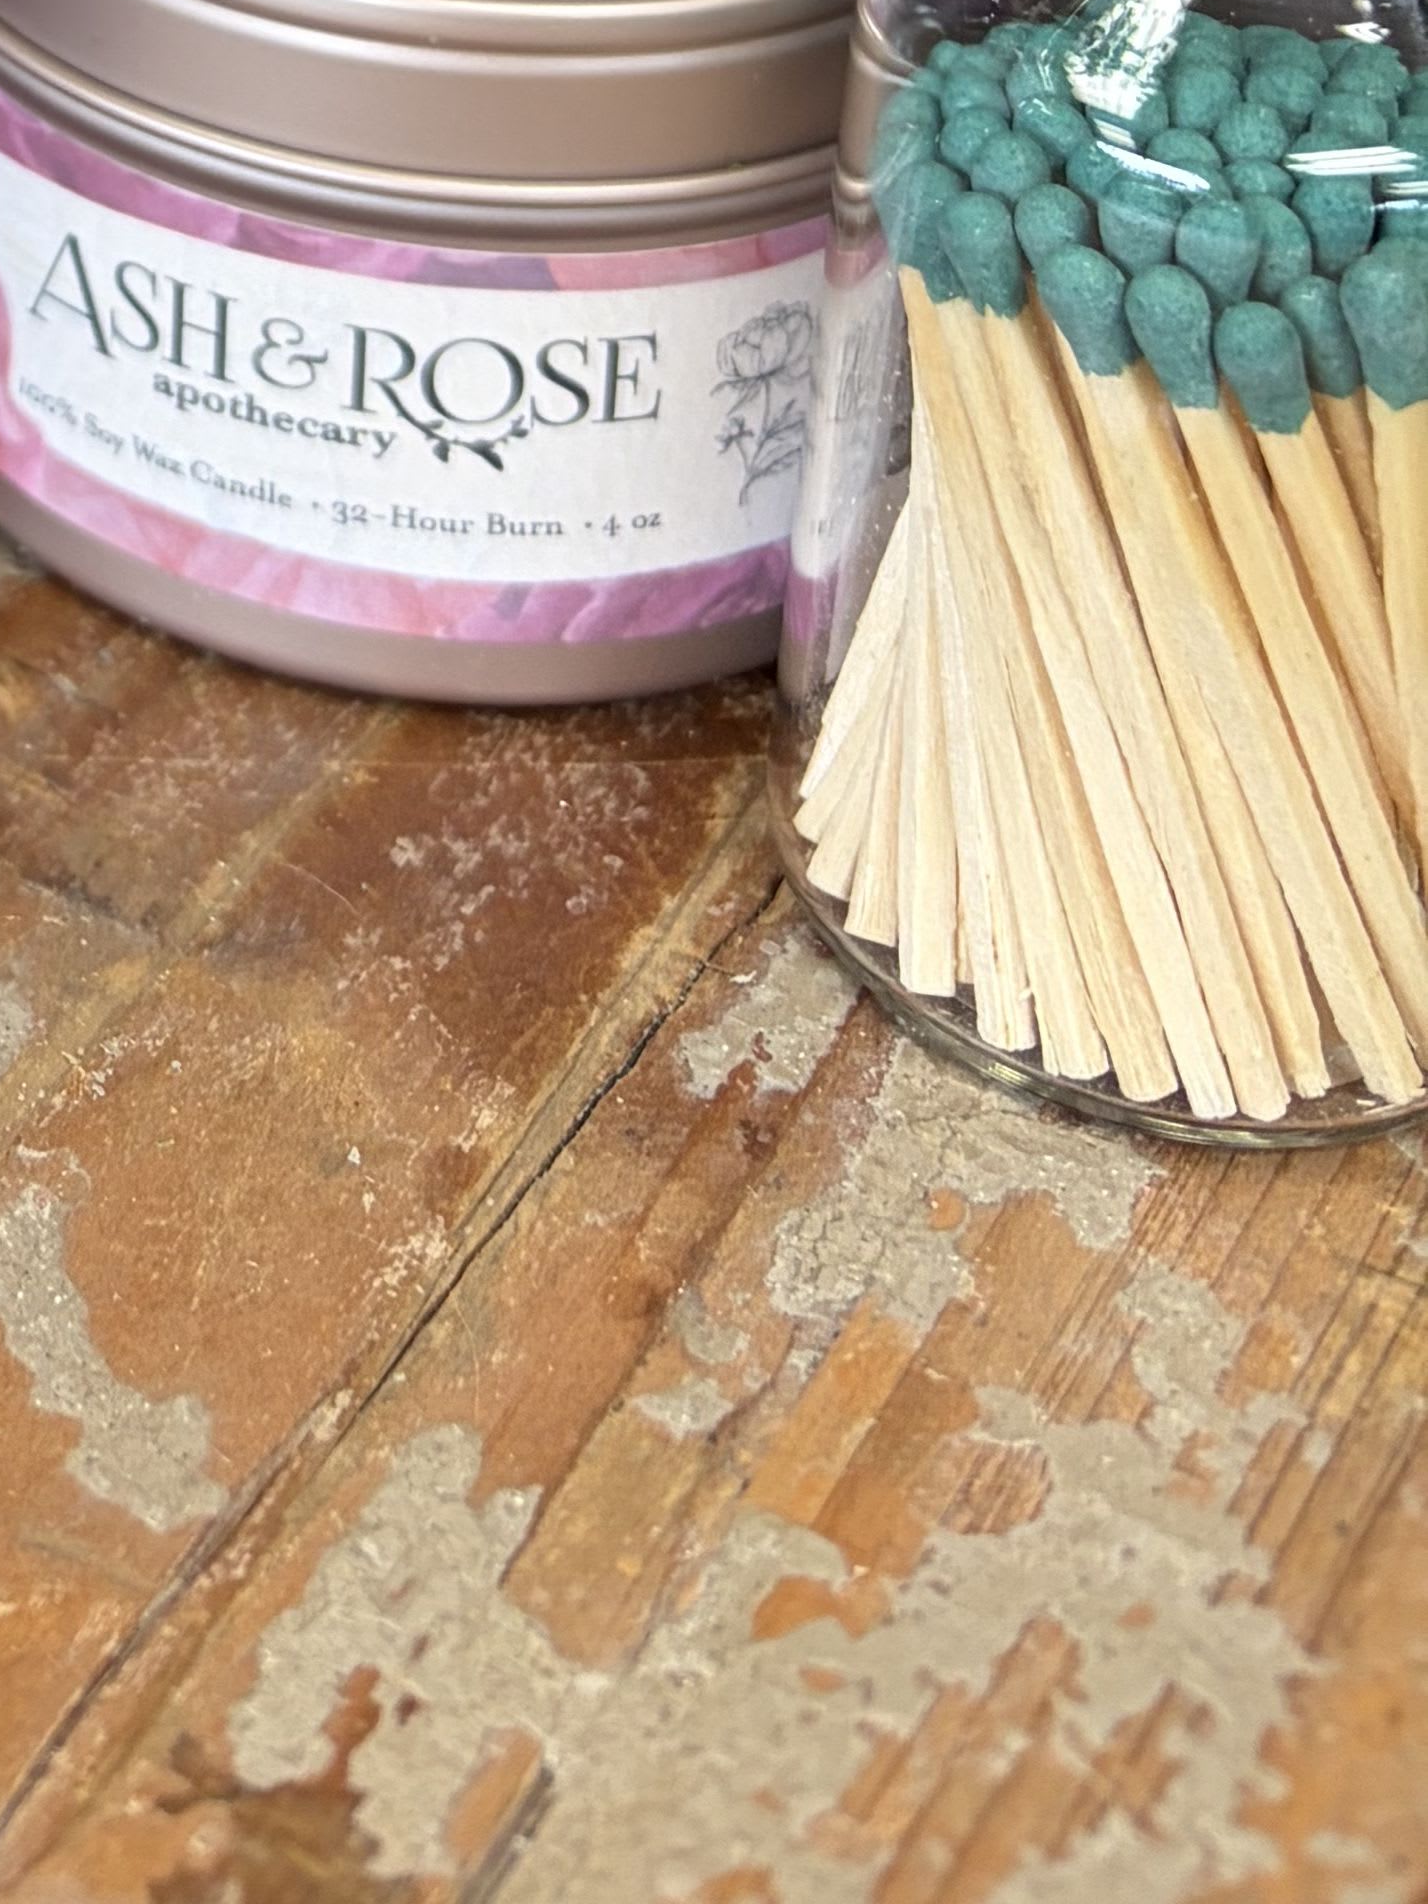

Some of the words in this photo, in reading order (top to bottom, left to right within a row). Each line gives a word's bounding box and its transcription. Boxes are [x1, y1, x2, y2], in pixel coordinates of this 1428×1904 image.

[29, 230, 238, 390] ASH
[344, 330, 662, 432] ROSE
[85, 412, 125, 454] Soy
[190, 459, 292, 509] Candle
[331, 500, 475, 535] 32-Hour
[486, 511, 564, 536] Burn
[602, 512, 620, 537] 4
[631, 511, 661, 529] oz
[153, 370, 400, 460] apothecary
